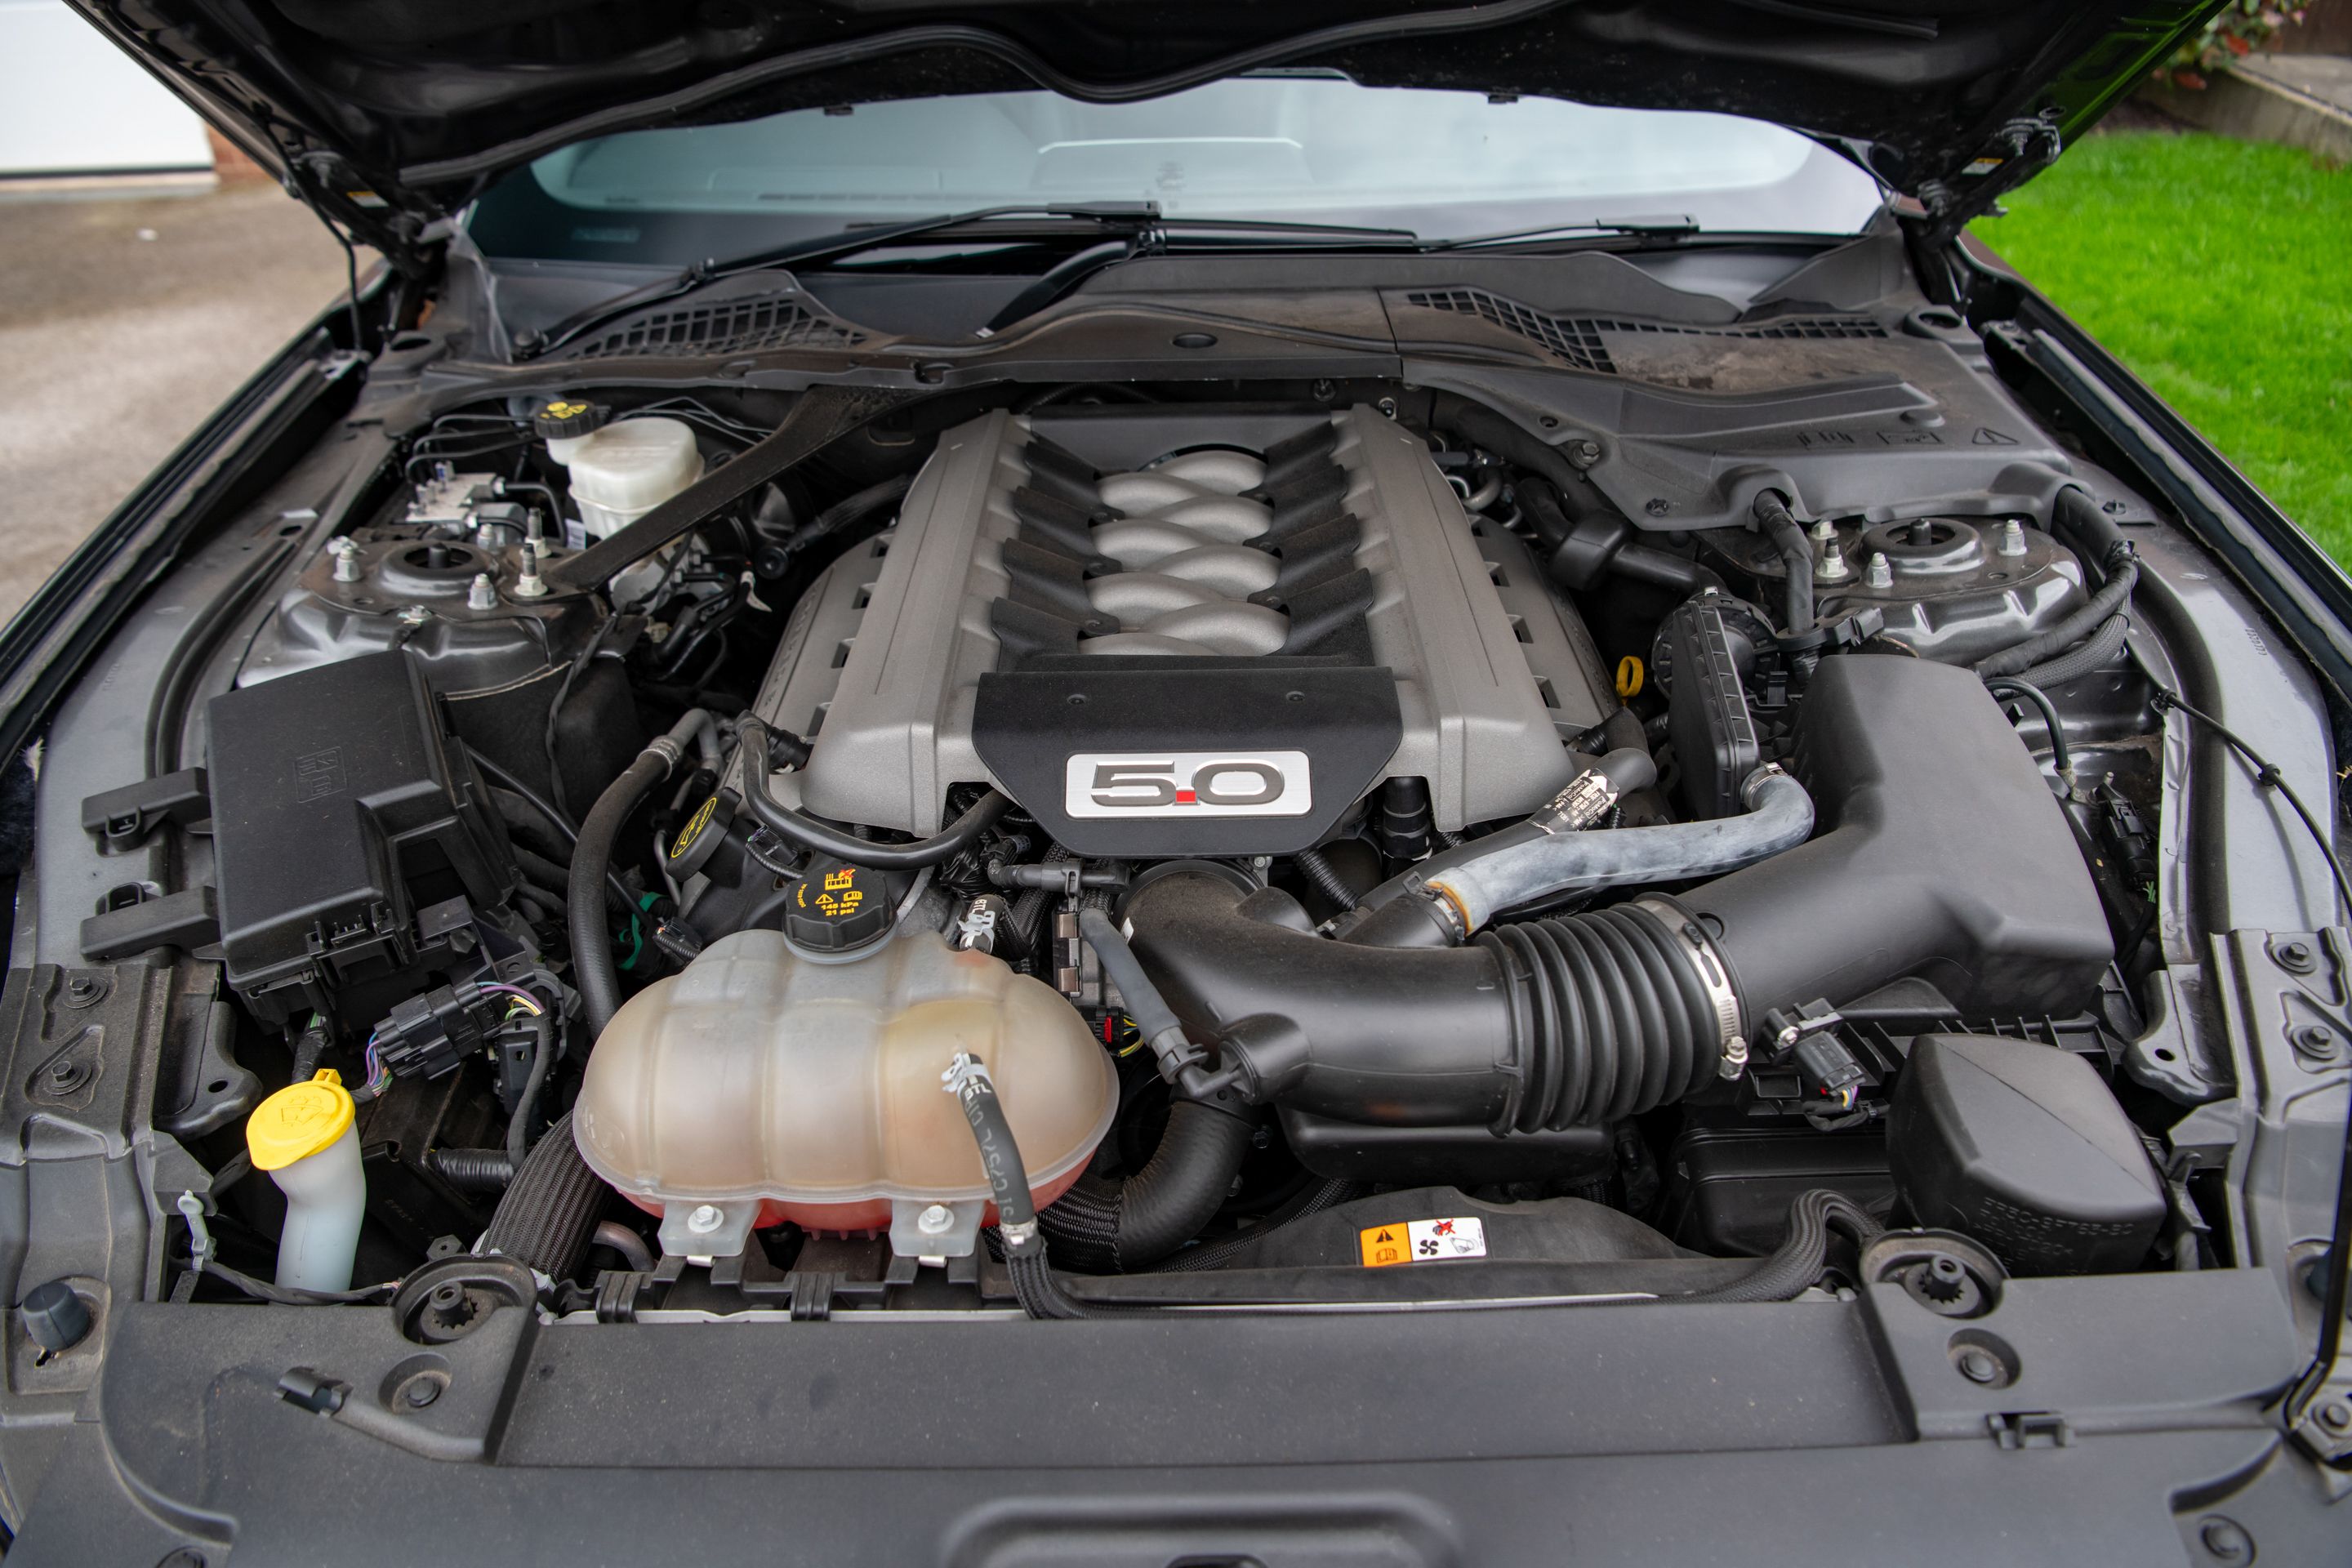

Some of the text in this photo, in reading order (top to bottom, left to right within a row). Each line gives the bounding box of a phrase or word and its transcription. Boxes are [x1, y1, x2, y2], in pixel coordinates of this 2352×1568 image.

[1091, 760, 1285, 807] 5.0
[1568, 781, 1589, 800] FoMoCo
[1585, 797, 1606, 817] FoMoCo
[964, 1083, 991, 1100] BTL
